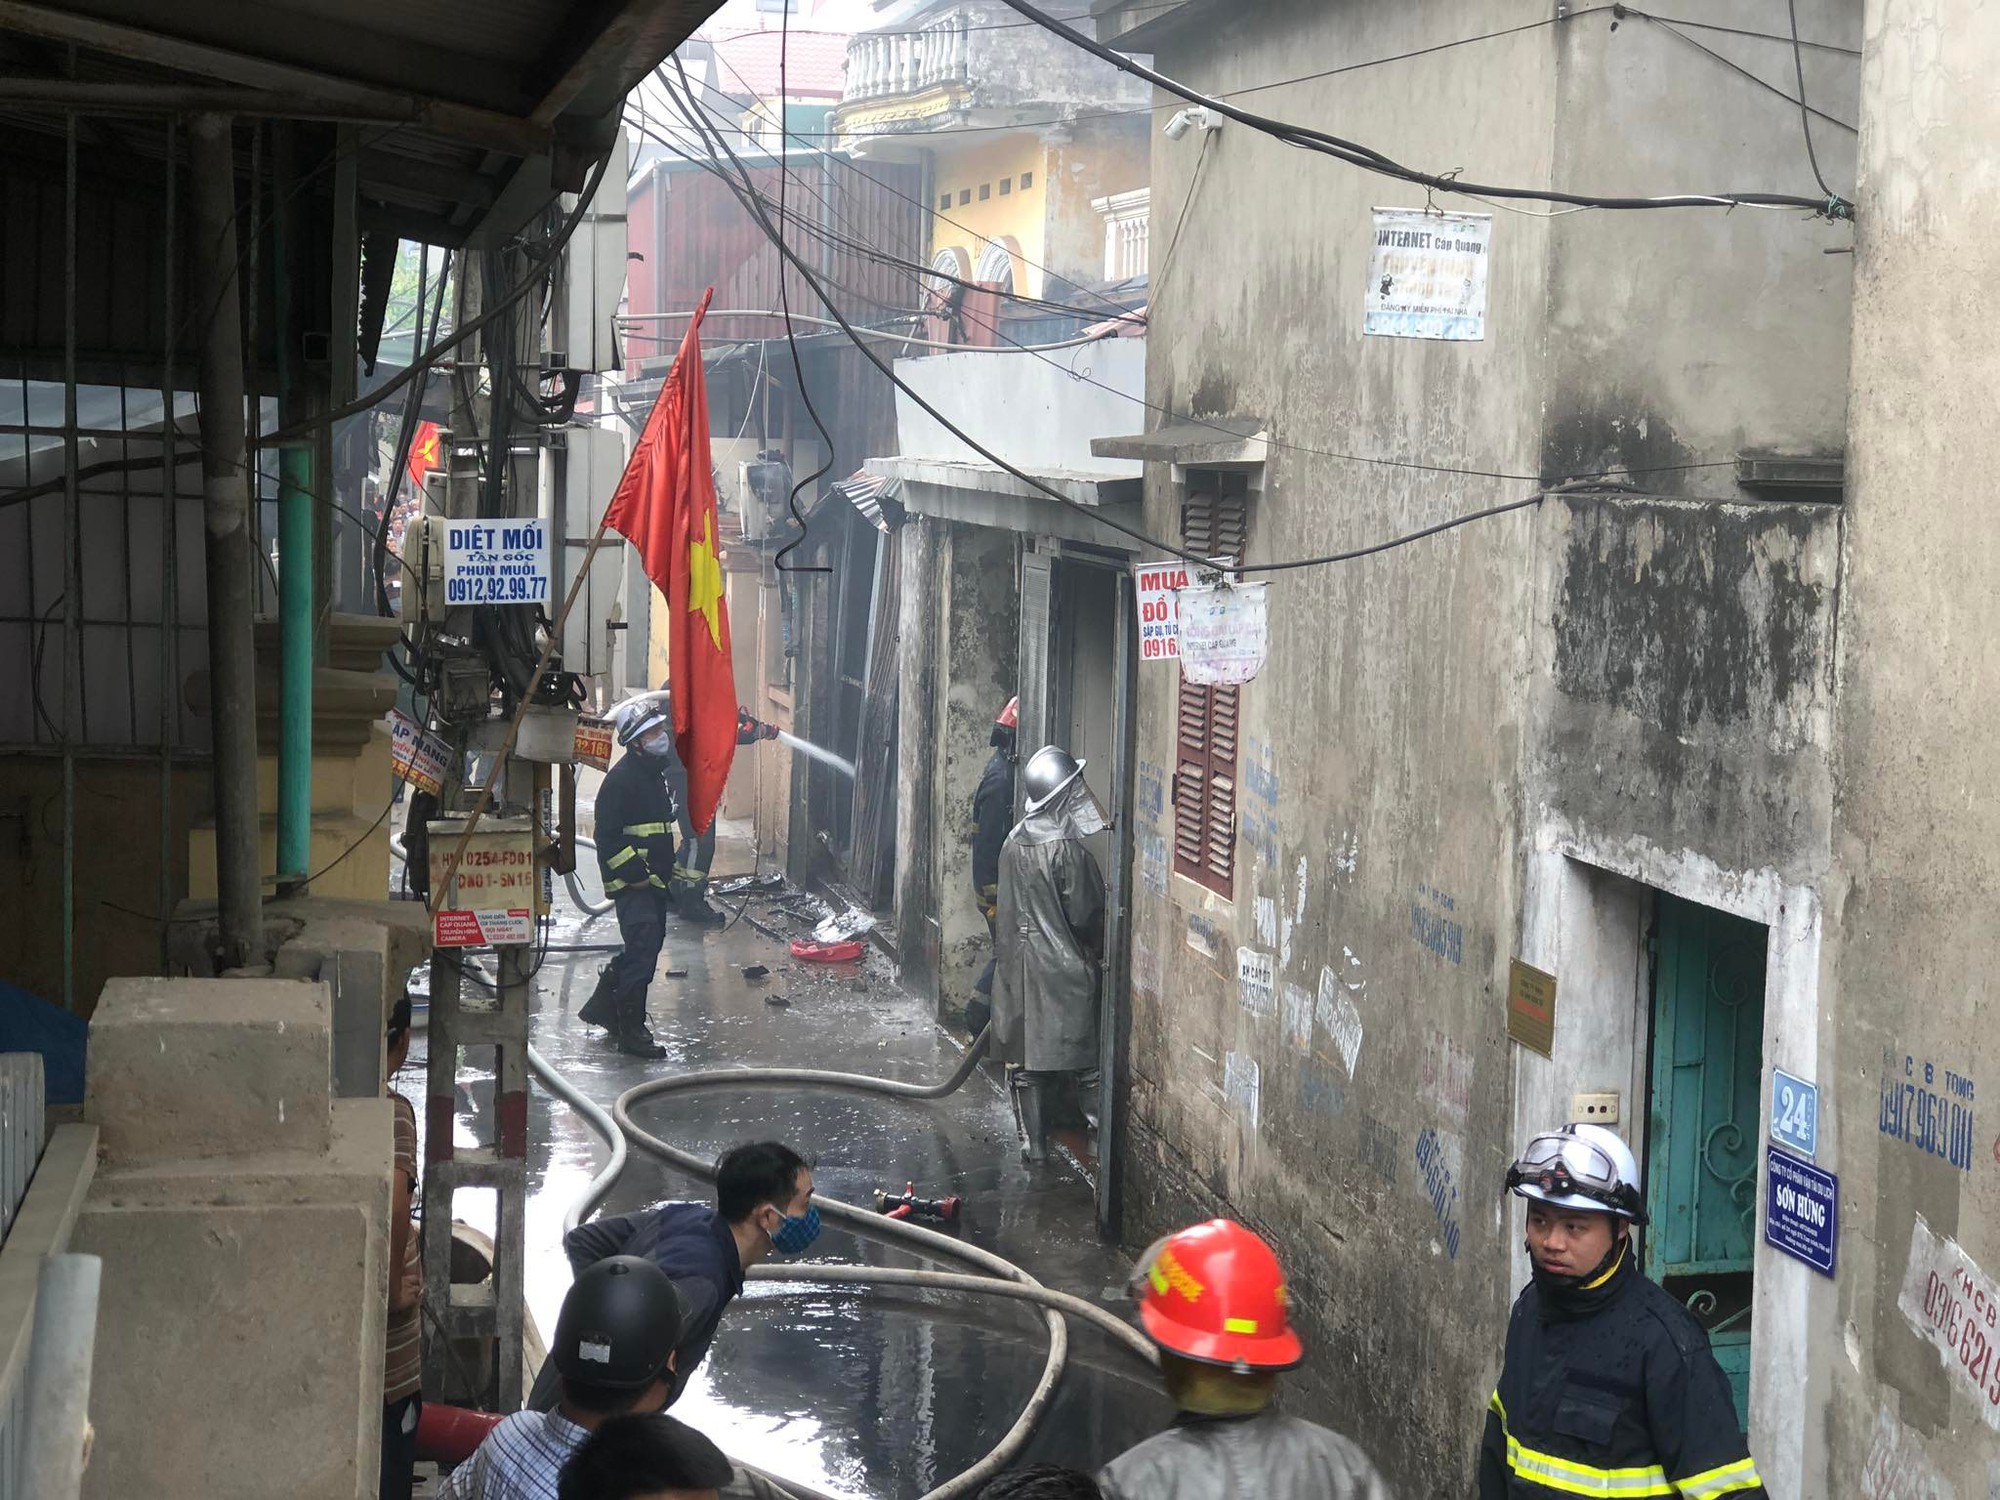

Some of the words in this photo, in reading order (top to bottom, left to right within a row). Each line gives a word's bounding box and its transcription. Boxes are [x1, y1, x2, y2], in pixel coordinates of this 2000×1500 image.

[1378, 230, 1432, 249] INTERNET
[1455, 239, 1482, 254] Quang
[503, 521, 542, 550] MỐI
[457, 565, 495, 576] PHUN
[1141, 570, 1189, 592] MUA
[448, 577, 547, 601] 0912.92.99.77
[1780, 1085, 1807, 1142] 24
[1777, 1183, 1796, 1213] SƠN
[1797, 1191, 1825, 1228] HÙNG
